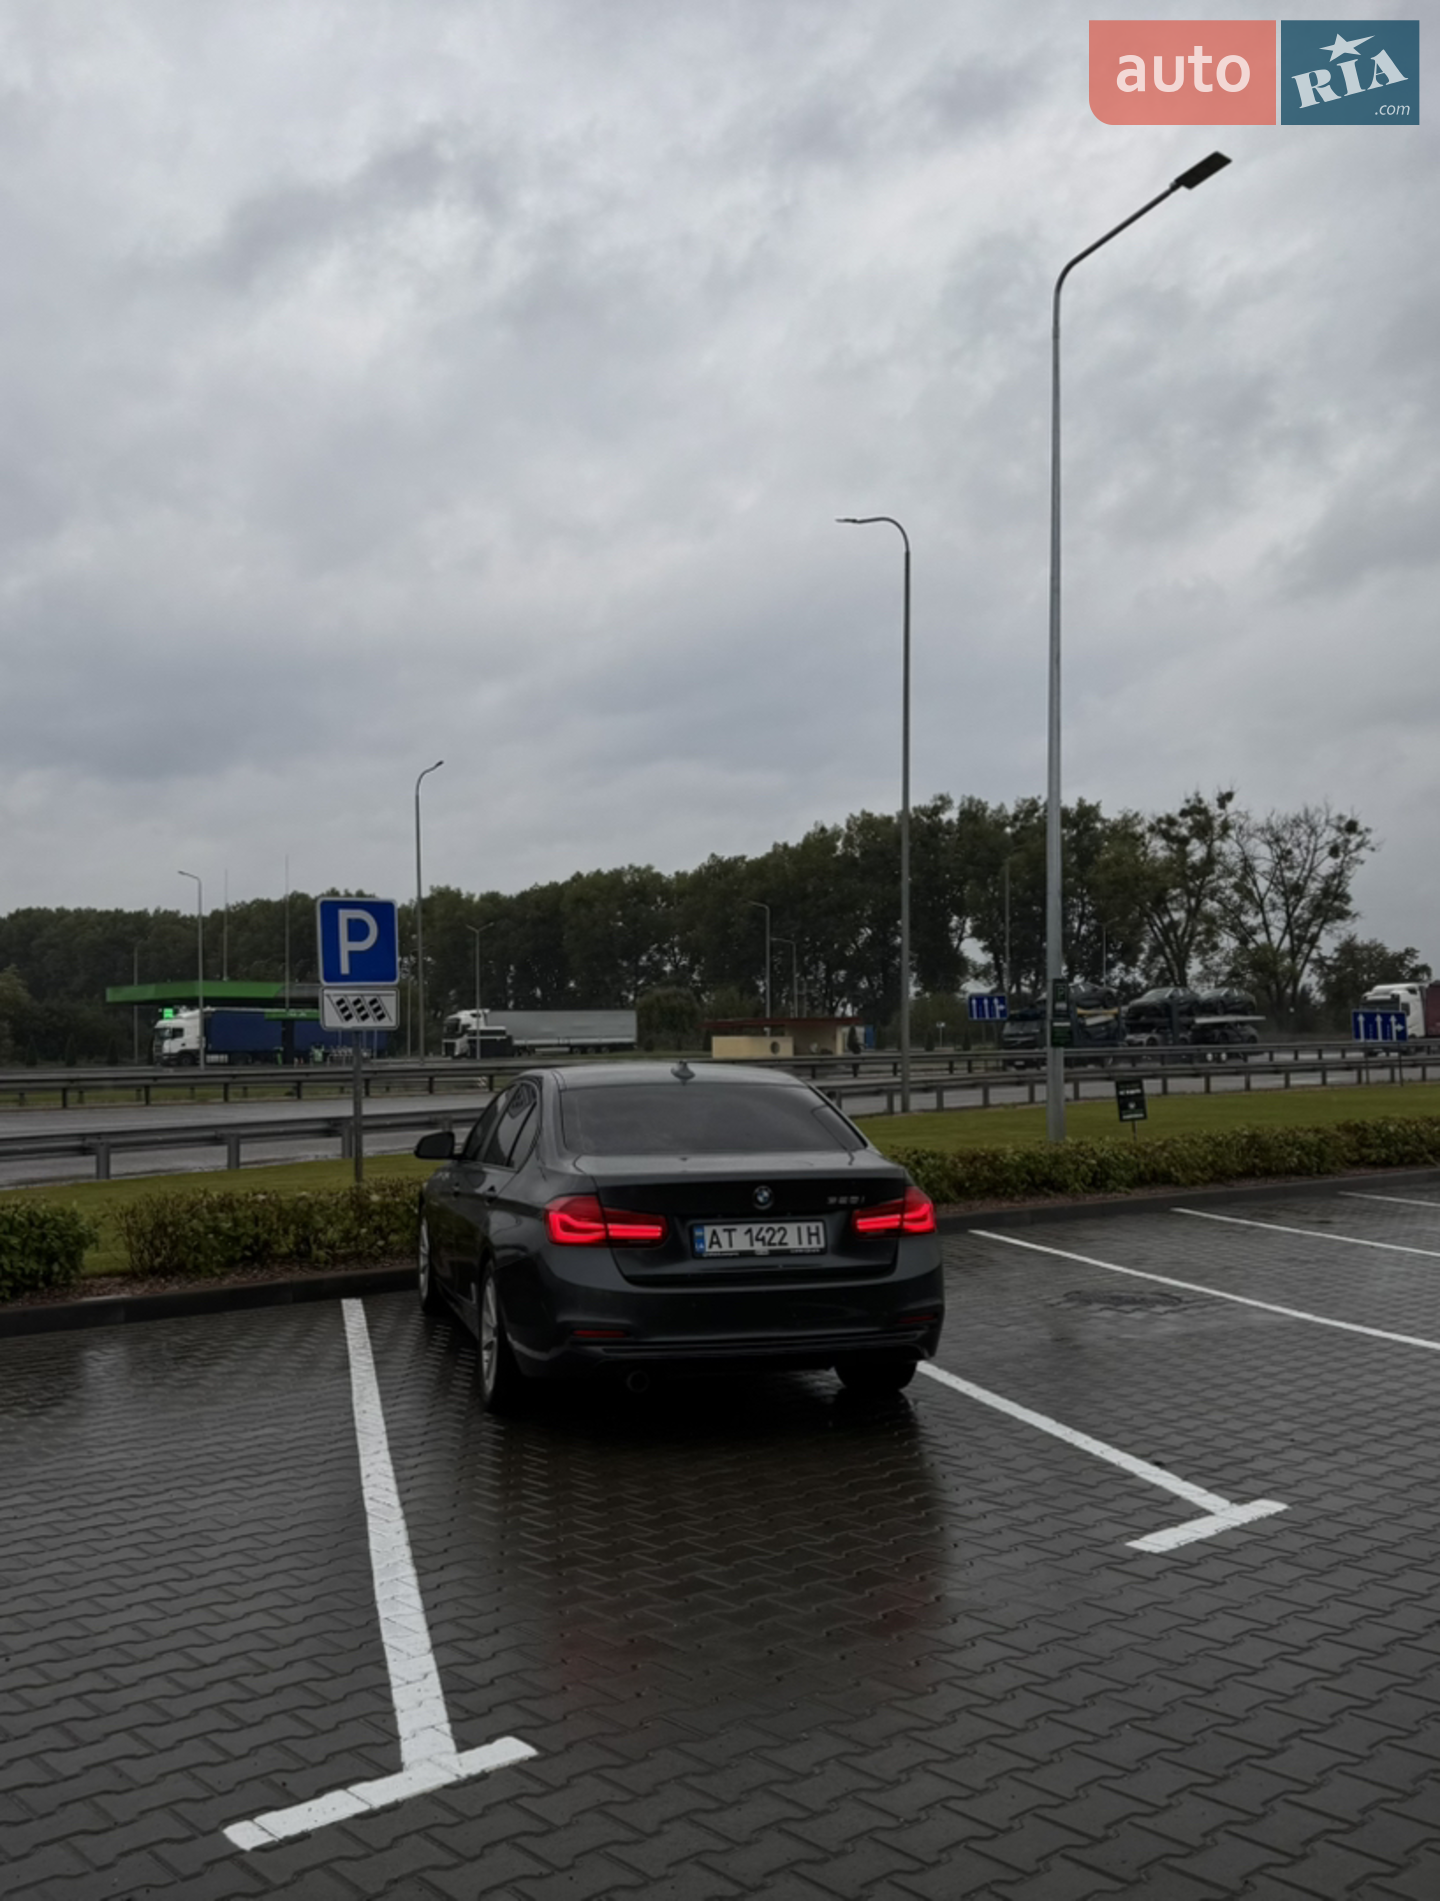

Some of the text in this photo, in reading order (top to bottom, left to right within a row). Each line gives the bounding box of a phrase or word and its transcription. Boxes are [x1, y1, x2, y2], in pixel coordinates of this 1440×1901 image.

[338, 909, 378, 975] P
[708, 1225, 821, 1249] AT 1422 IH
